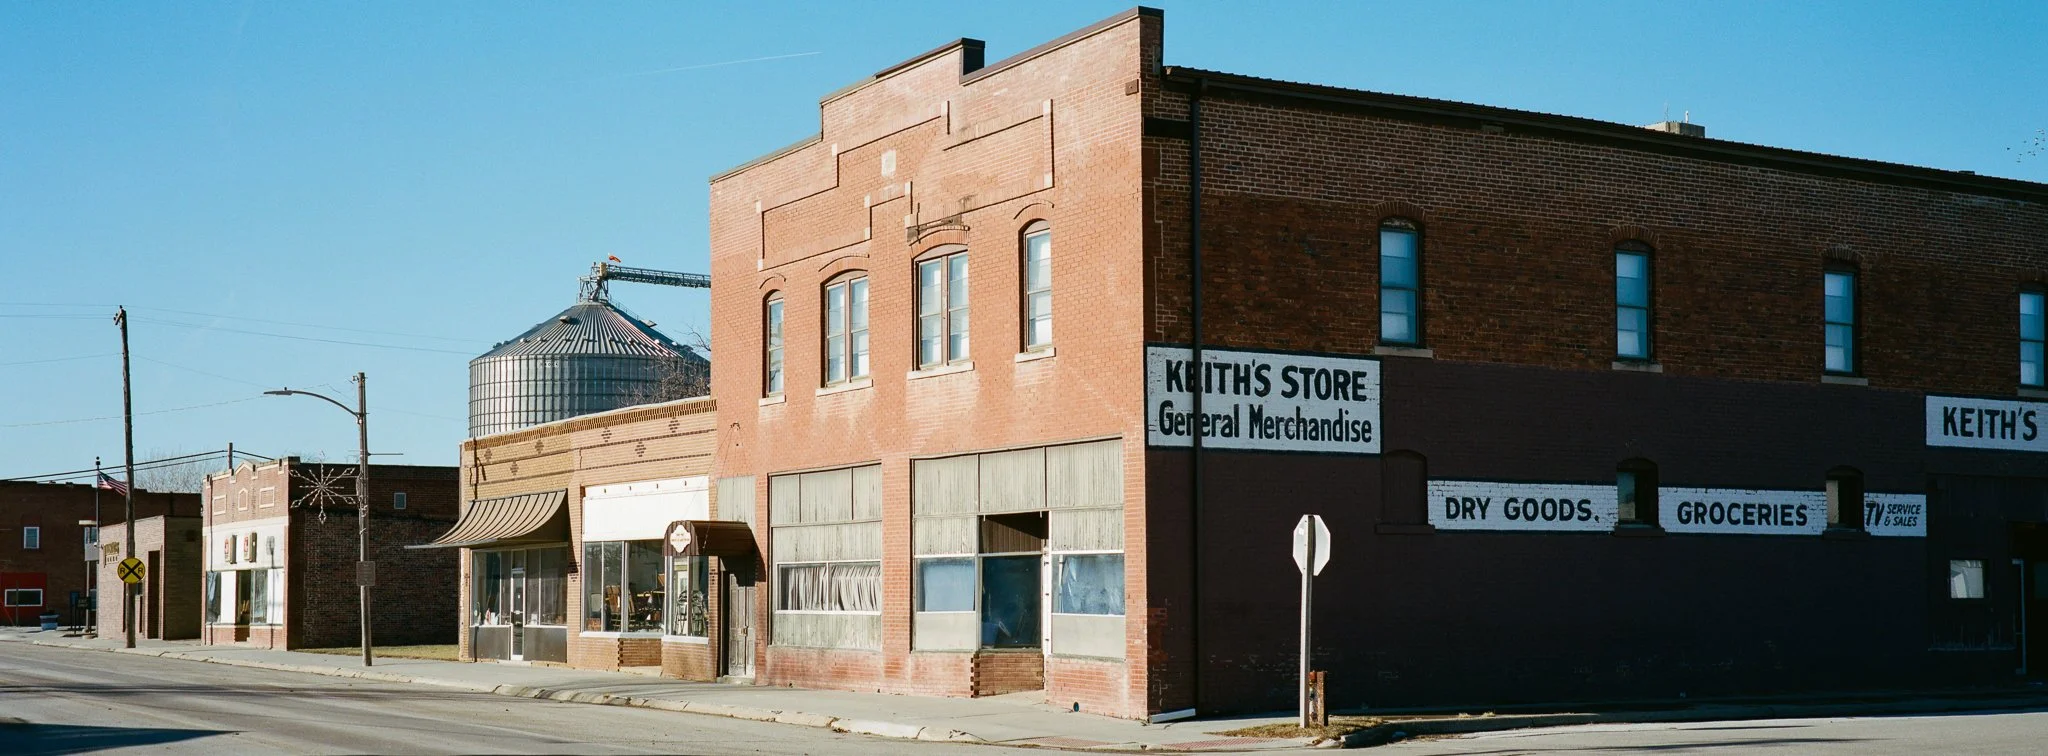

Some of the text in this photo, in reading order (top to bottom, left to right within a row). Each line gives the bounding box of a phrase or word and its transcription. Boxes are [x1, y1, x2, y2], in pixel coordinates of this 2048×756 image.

[1166, 359, 1367, 401] KEITH'S STORE
[1159, 400, 1372, 443] General Merchandise
[1943, 406, 2038, 441] KEITH'S
[1445, 497, 1600, 523] DRY GOODS.
[1677, 501, 1808, 526] GROCERIES
[1866, 502, 1885, 526] TV
[1884, 516, 1917, 526] & SALES
[1887, 504, 1921, 514] SERVICE
